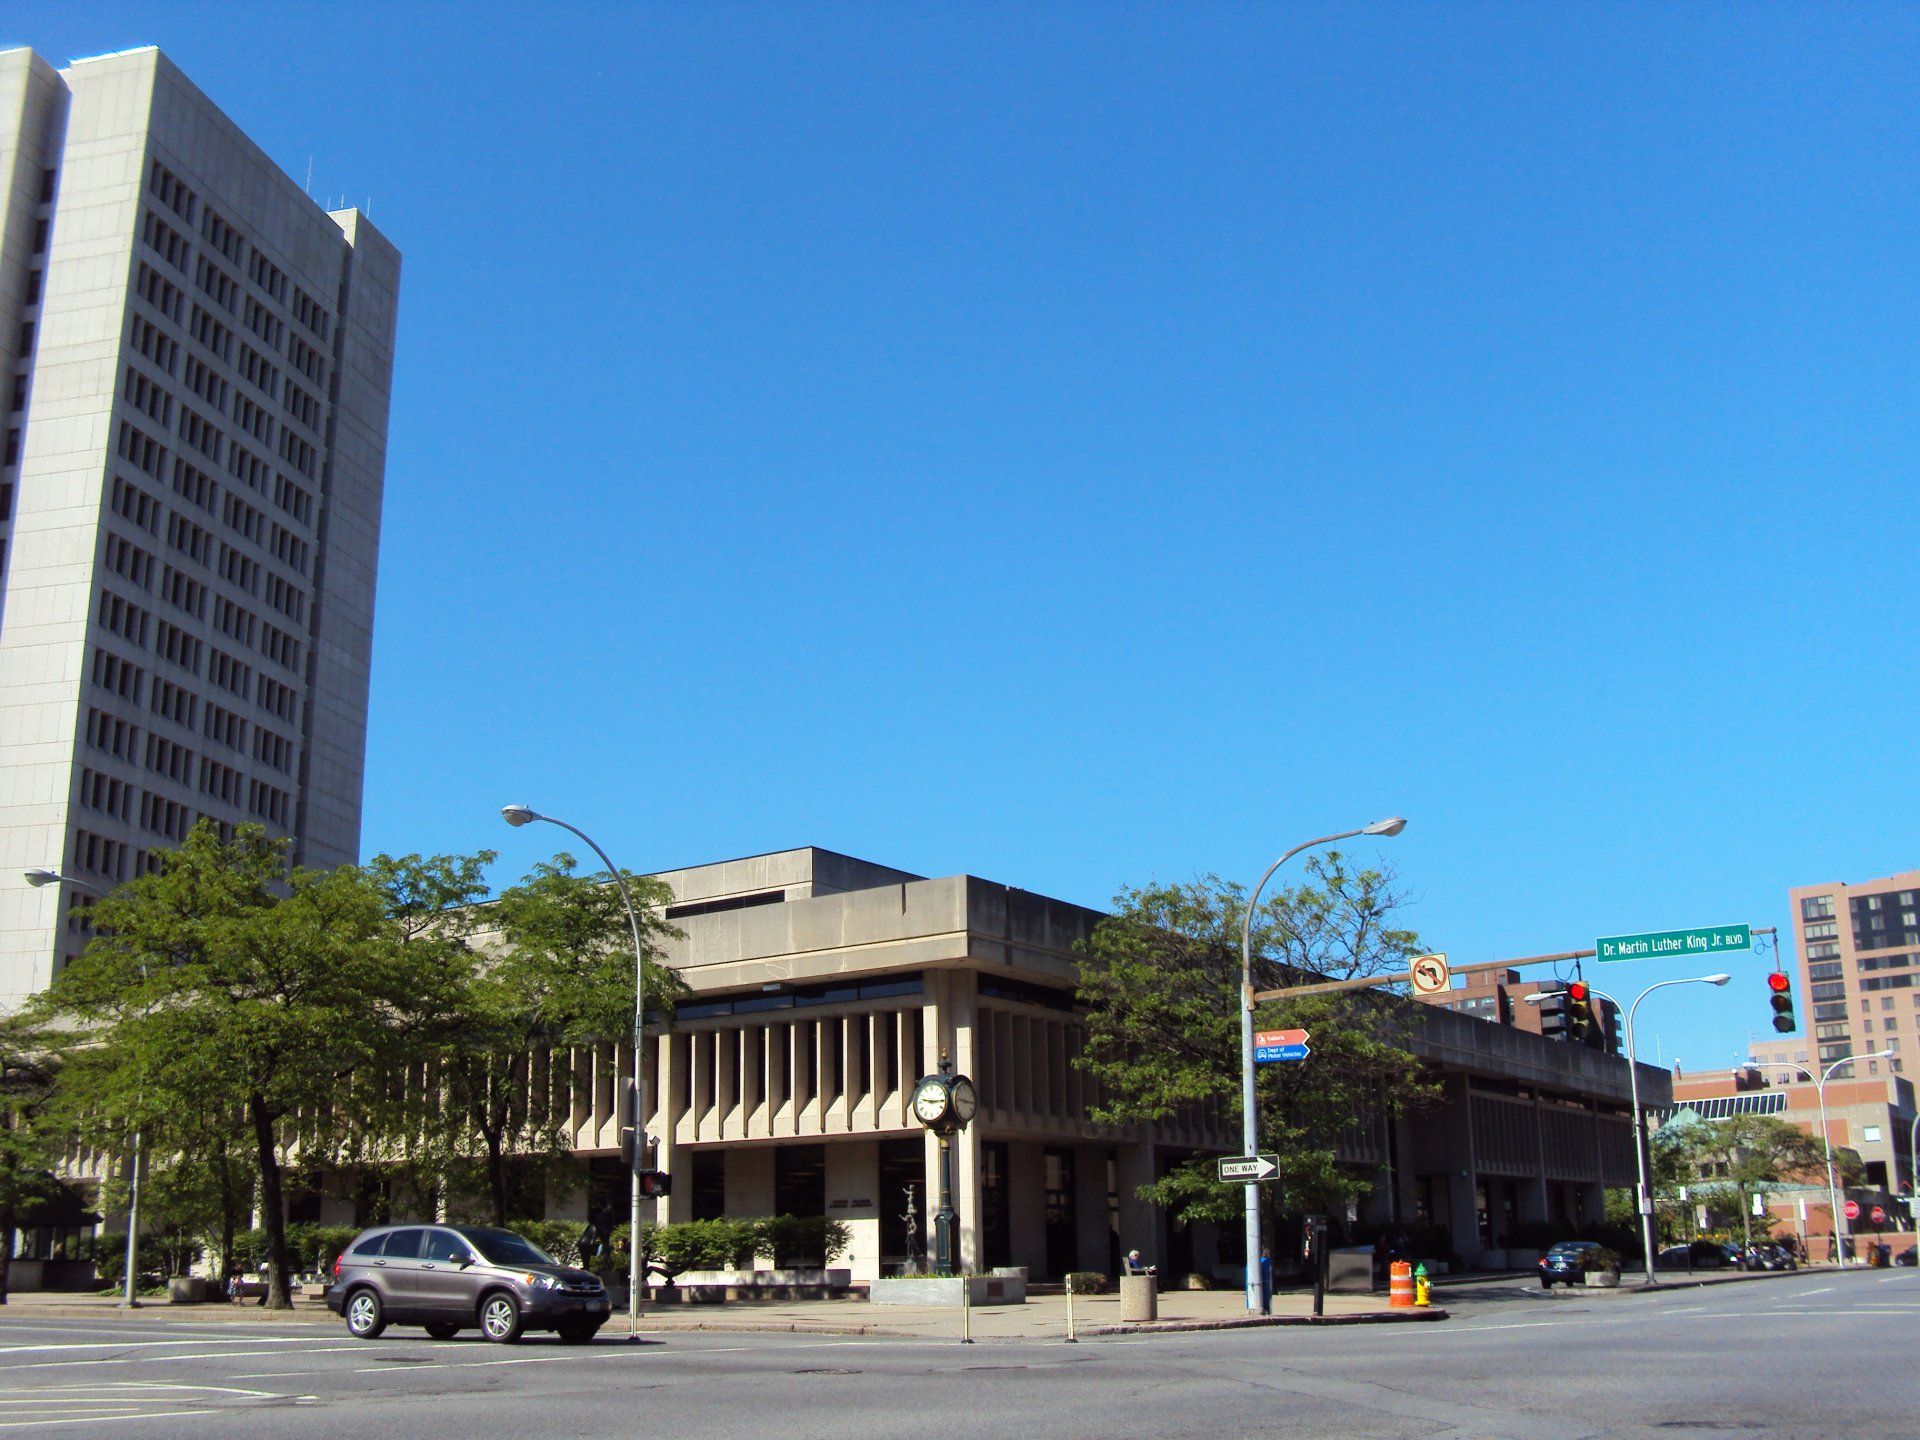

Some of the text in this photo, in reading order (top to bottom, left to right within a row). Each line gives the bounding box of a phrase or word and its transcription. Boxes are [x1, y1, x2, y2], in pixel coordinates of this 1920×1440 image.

[1603, 933, 1743, 956] Dr. Martin Luther King Jr. BLVD
[1224, 1164, 1258, 1174] ONE WAY
